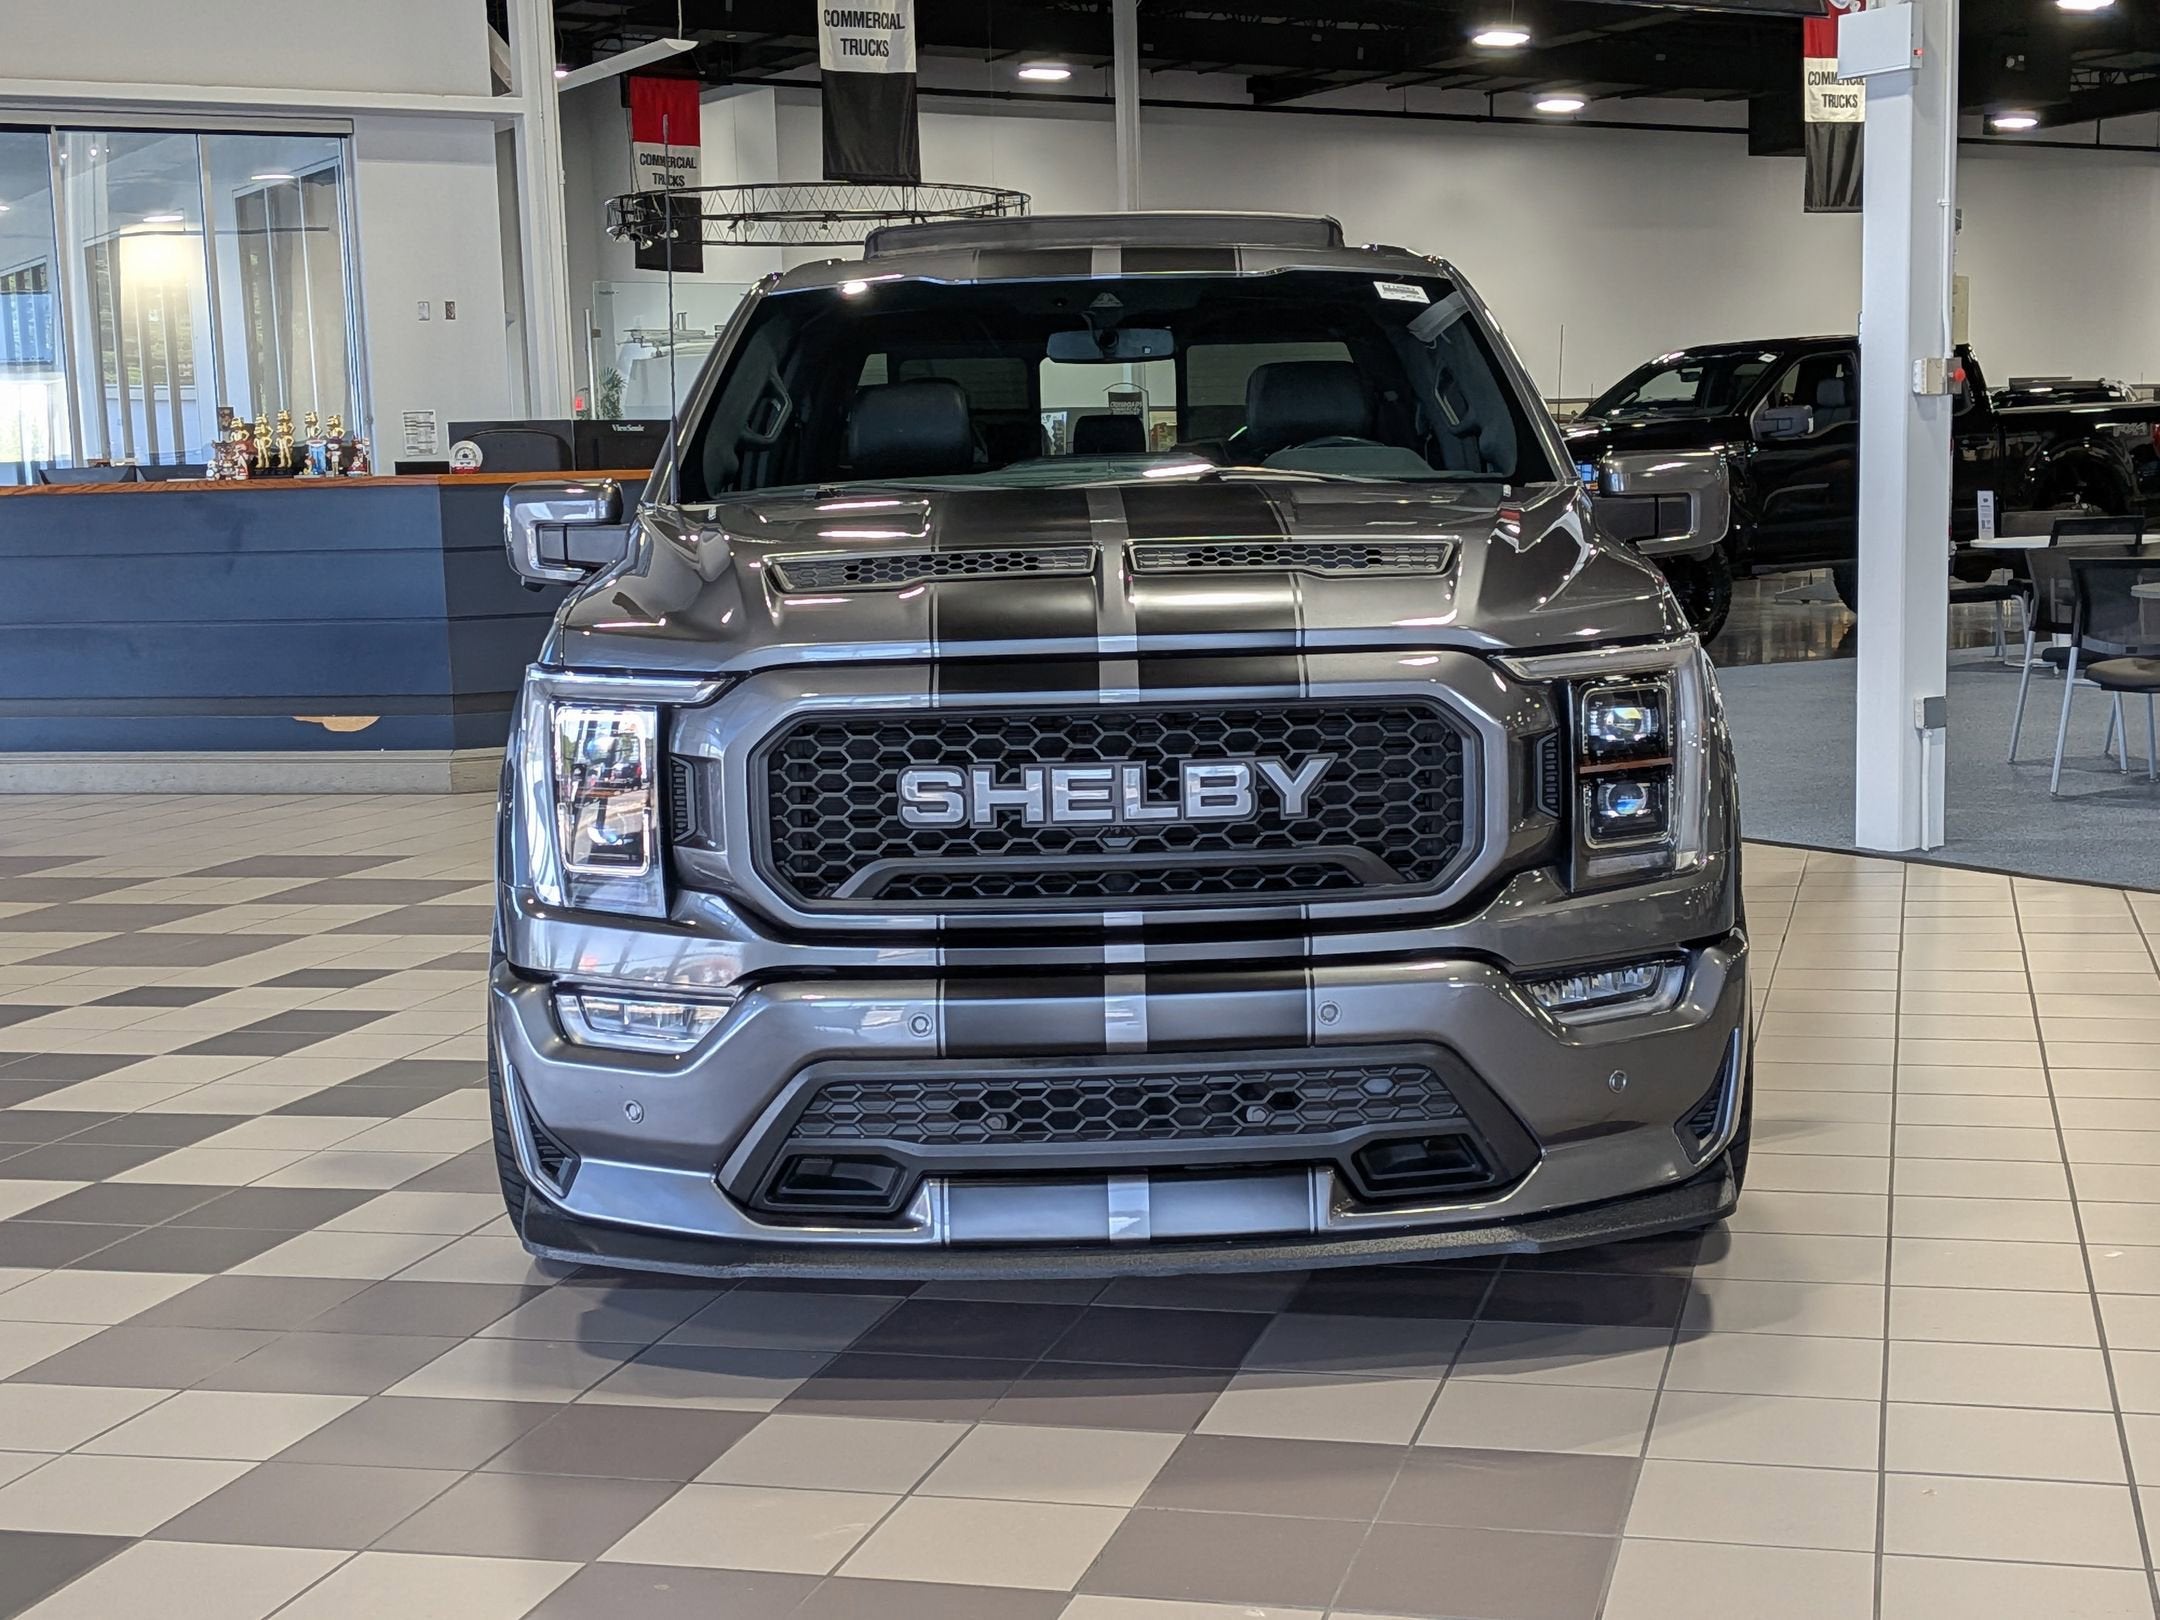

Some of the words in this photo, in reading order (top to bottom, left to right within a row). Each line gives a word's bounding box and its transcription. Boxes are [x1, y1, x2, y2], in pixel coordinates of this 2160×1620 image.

[823, 9, 905, 30] COMMERCIAL
[840, 38, 889, 57] TRUCKS
[1821, 93, 1858, 108] TRUCKS
[900, 755, 1337, 829] SHELBY
